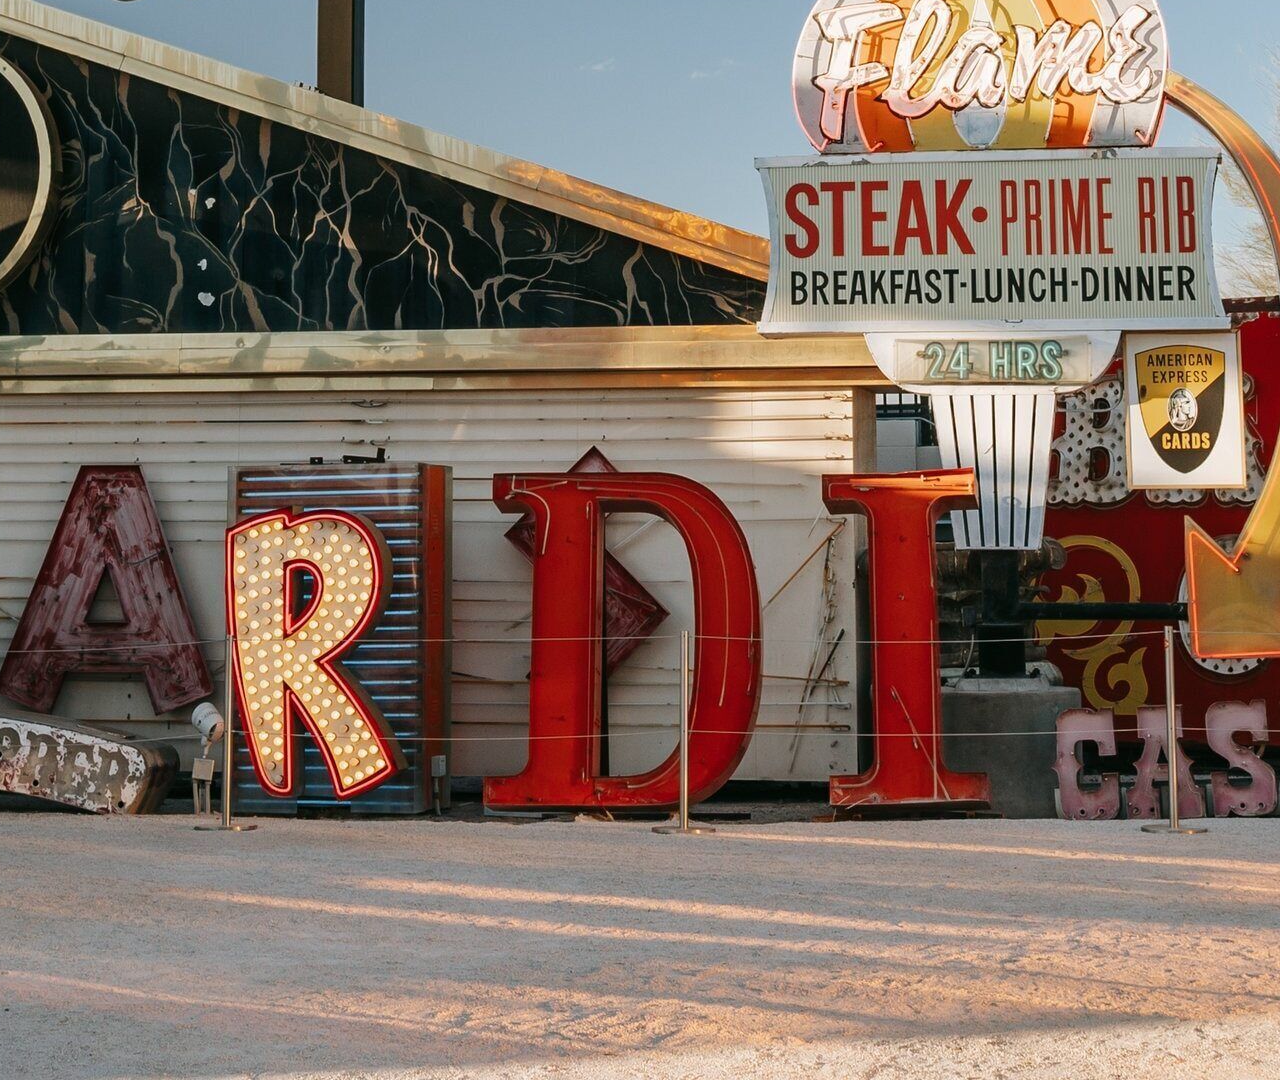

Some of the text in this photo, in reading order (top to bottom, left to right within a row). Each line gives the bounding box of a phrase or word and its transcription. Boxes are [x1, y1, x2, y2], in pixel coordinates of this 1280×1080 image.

[1138, 176, 1196, 254] RIB
[925, 340, 1064, 381] 24 HRS
[1147, 353, 1213, 368] AMERICAN
[1152, 370, 1208, 384] EXPRESS
[1162, 432, 1211, 450] CARDS
